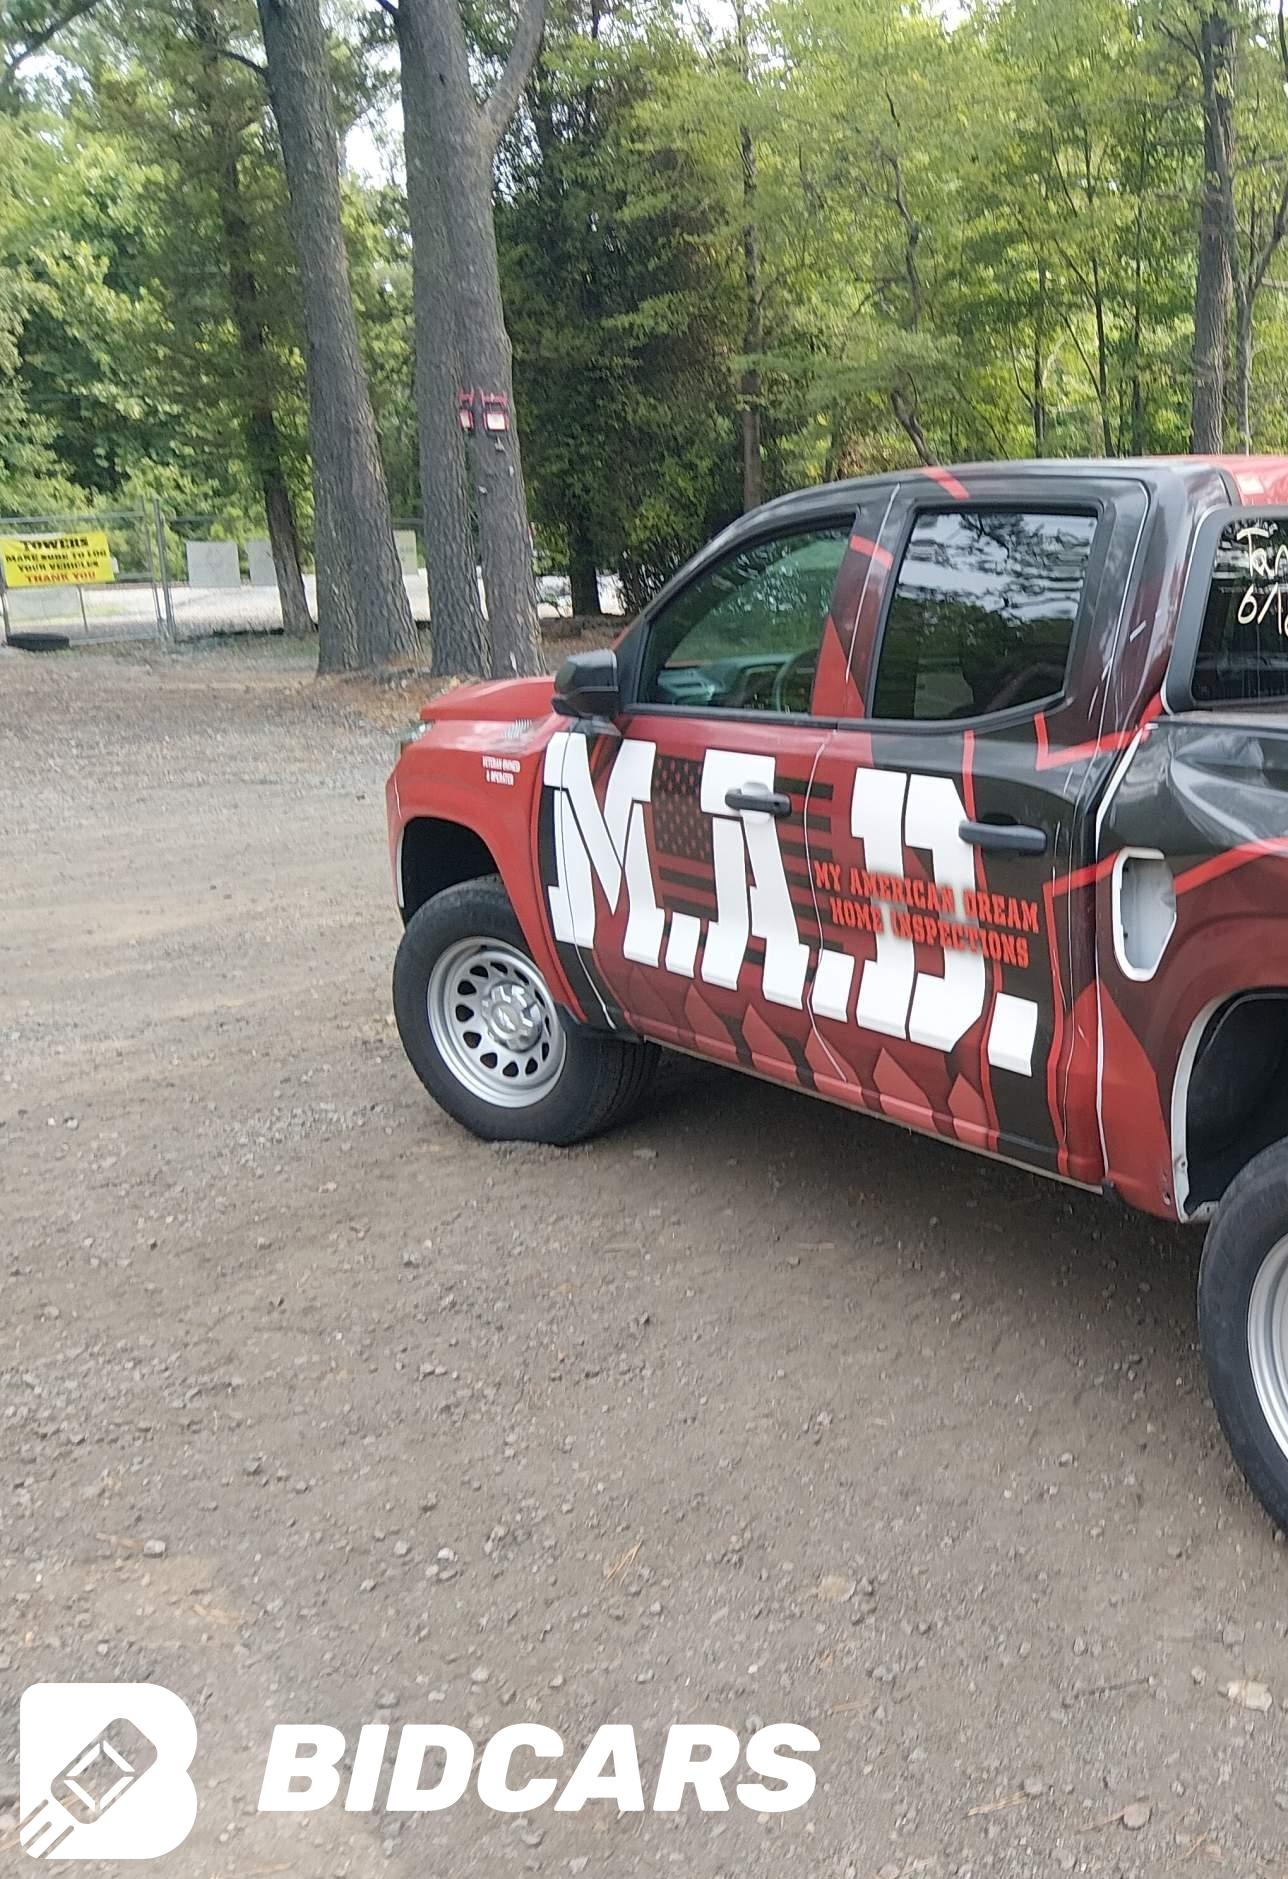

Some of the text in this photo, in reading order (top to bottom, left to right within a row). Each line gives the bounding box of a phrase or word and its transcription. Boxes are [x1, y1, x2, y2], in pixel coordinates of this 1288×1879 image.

[21, 537, 88, 551] TOWERS
[18, 563, 47, 572] YOUR
[25, 571, 96, 583] THANK YOU
[814, 860, 1040, 934] MY AMERICAN DREAM
[830, 896, 1031, 969] HOME INSPECTIONS
